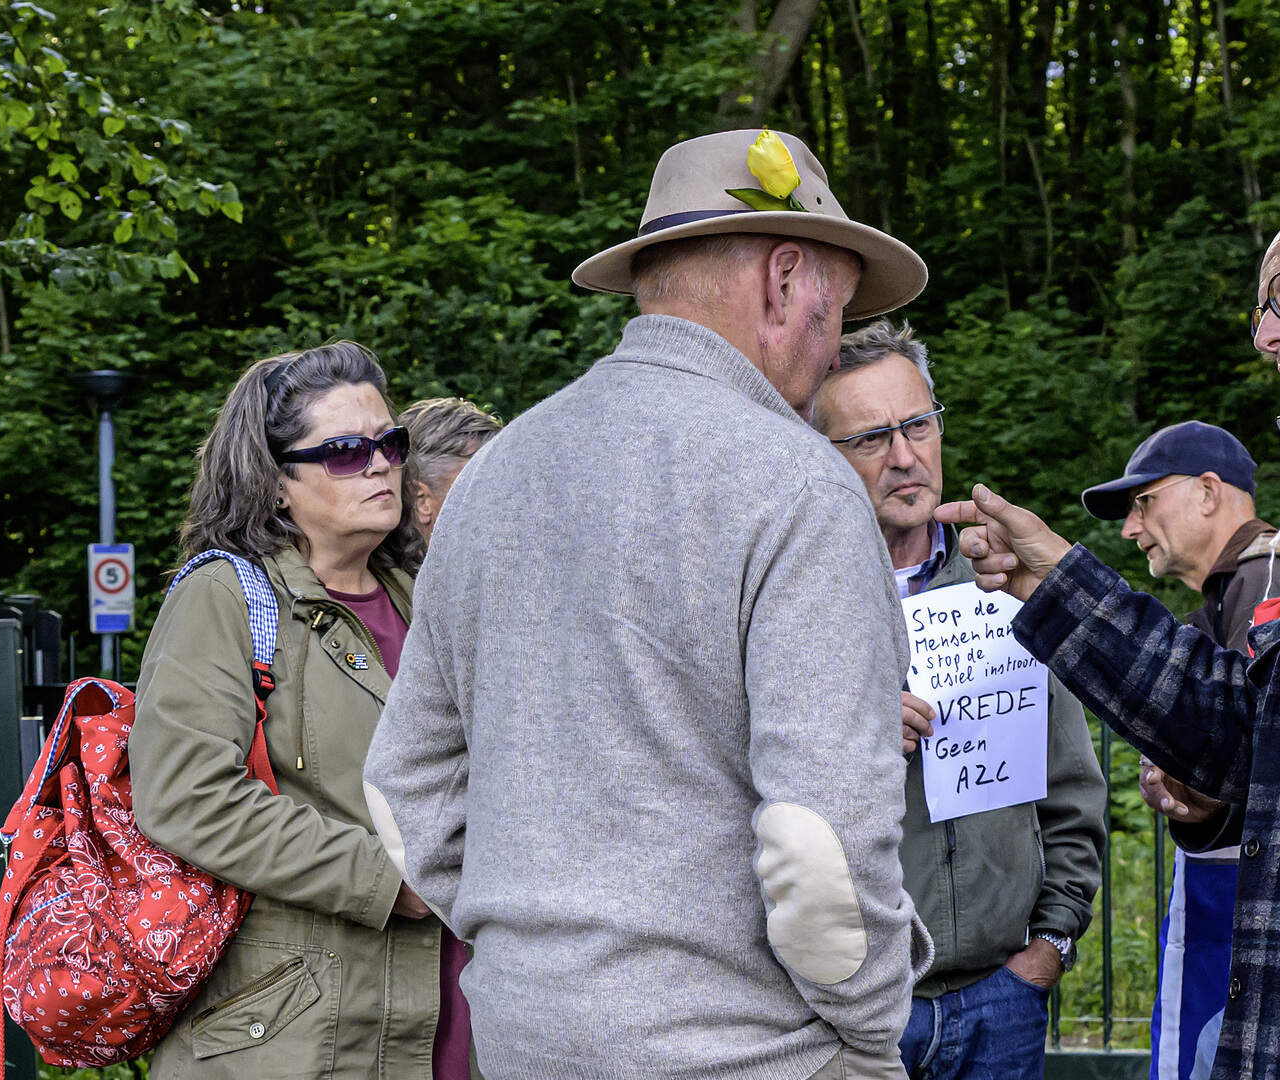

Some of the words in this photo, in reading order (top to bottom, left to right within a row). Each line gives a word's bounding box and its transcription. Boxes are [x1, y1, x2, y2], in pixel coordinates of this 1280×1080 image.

[106, 567, 118, 584] 5
[912, 607, 961, 632] Stop
[975, 599, 1000, 616] de
[967, 648, 985, 663] de
[937, 686, 1038, 727] VREDE
[935, 737, 987, 760] Geen
